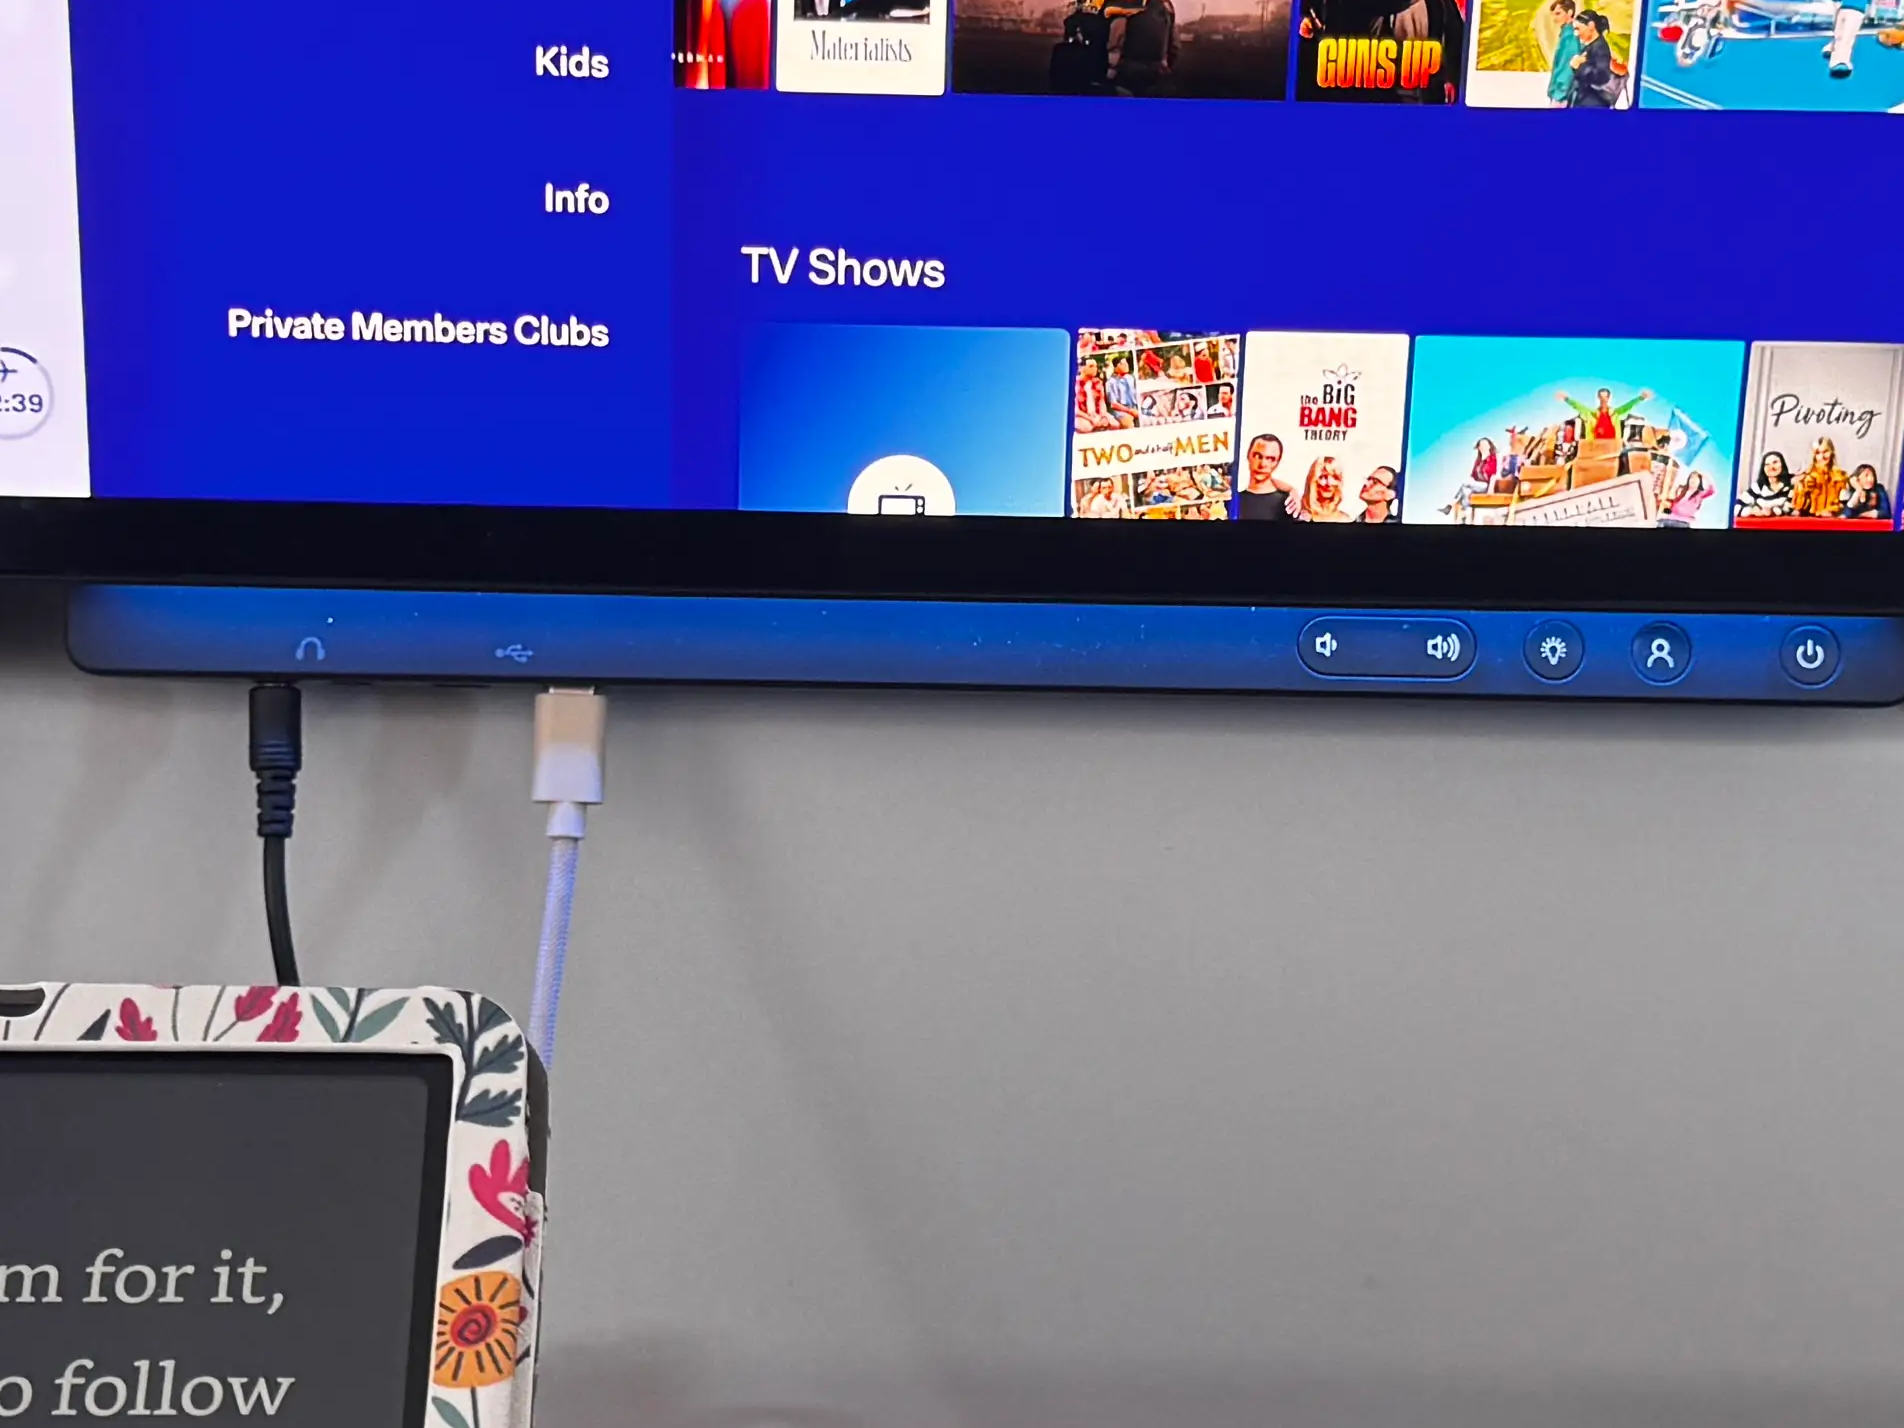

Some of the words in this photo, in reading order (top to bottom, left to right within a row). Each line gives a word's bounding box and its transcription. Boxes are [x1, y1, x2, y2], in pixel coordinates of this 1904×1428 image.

[536, 45, 609, 78] Kids
[810, 29, 913, 63] Materialists
[1317, 39, 1397, 88] GUNS
[1401, 40, 1442, 88] UP
[545, 183, 609, 214] Info
[741, 247, 799, 284] TV
[809, 248, 945, 287] Shows
[228, 308, 345, 340] Private
[352, 311, 508, 344] Members
[514, 315, 609, 347] Clubs
[1299, 406, 1358, 428] BANG
[1770, 393, 1882, 440] Pivoting
[1078, 443, 1133, 467] TWO
[1175, 431, 1229, 456] MEN
[83, 1248, 195, 1303] for
[210, 1249, 283, 1314] it,
[52, 1359, 295, 1416] follow
